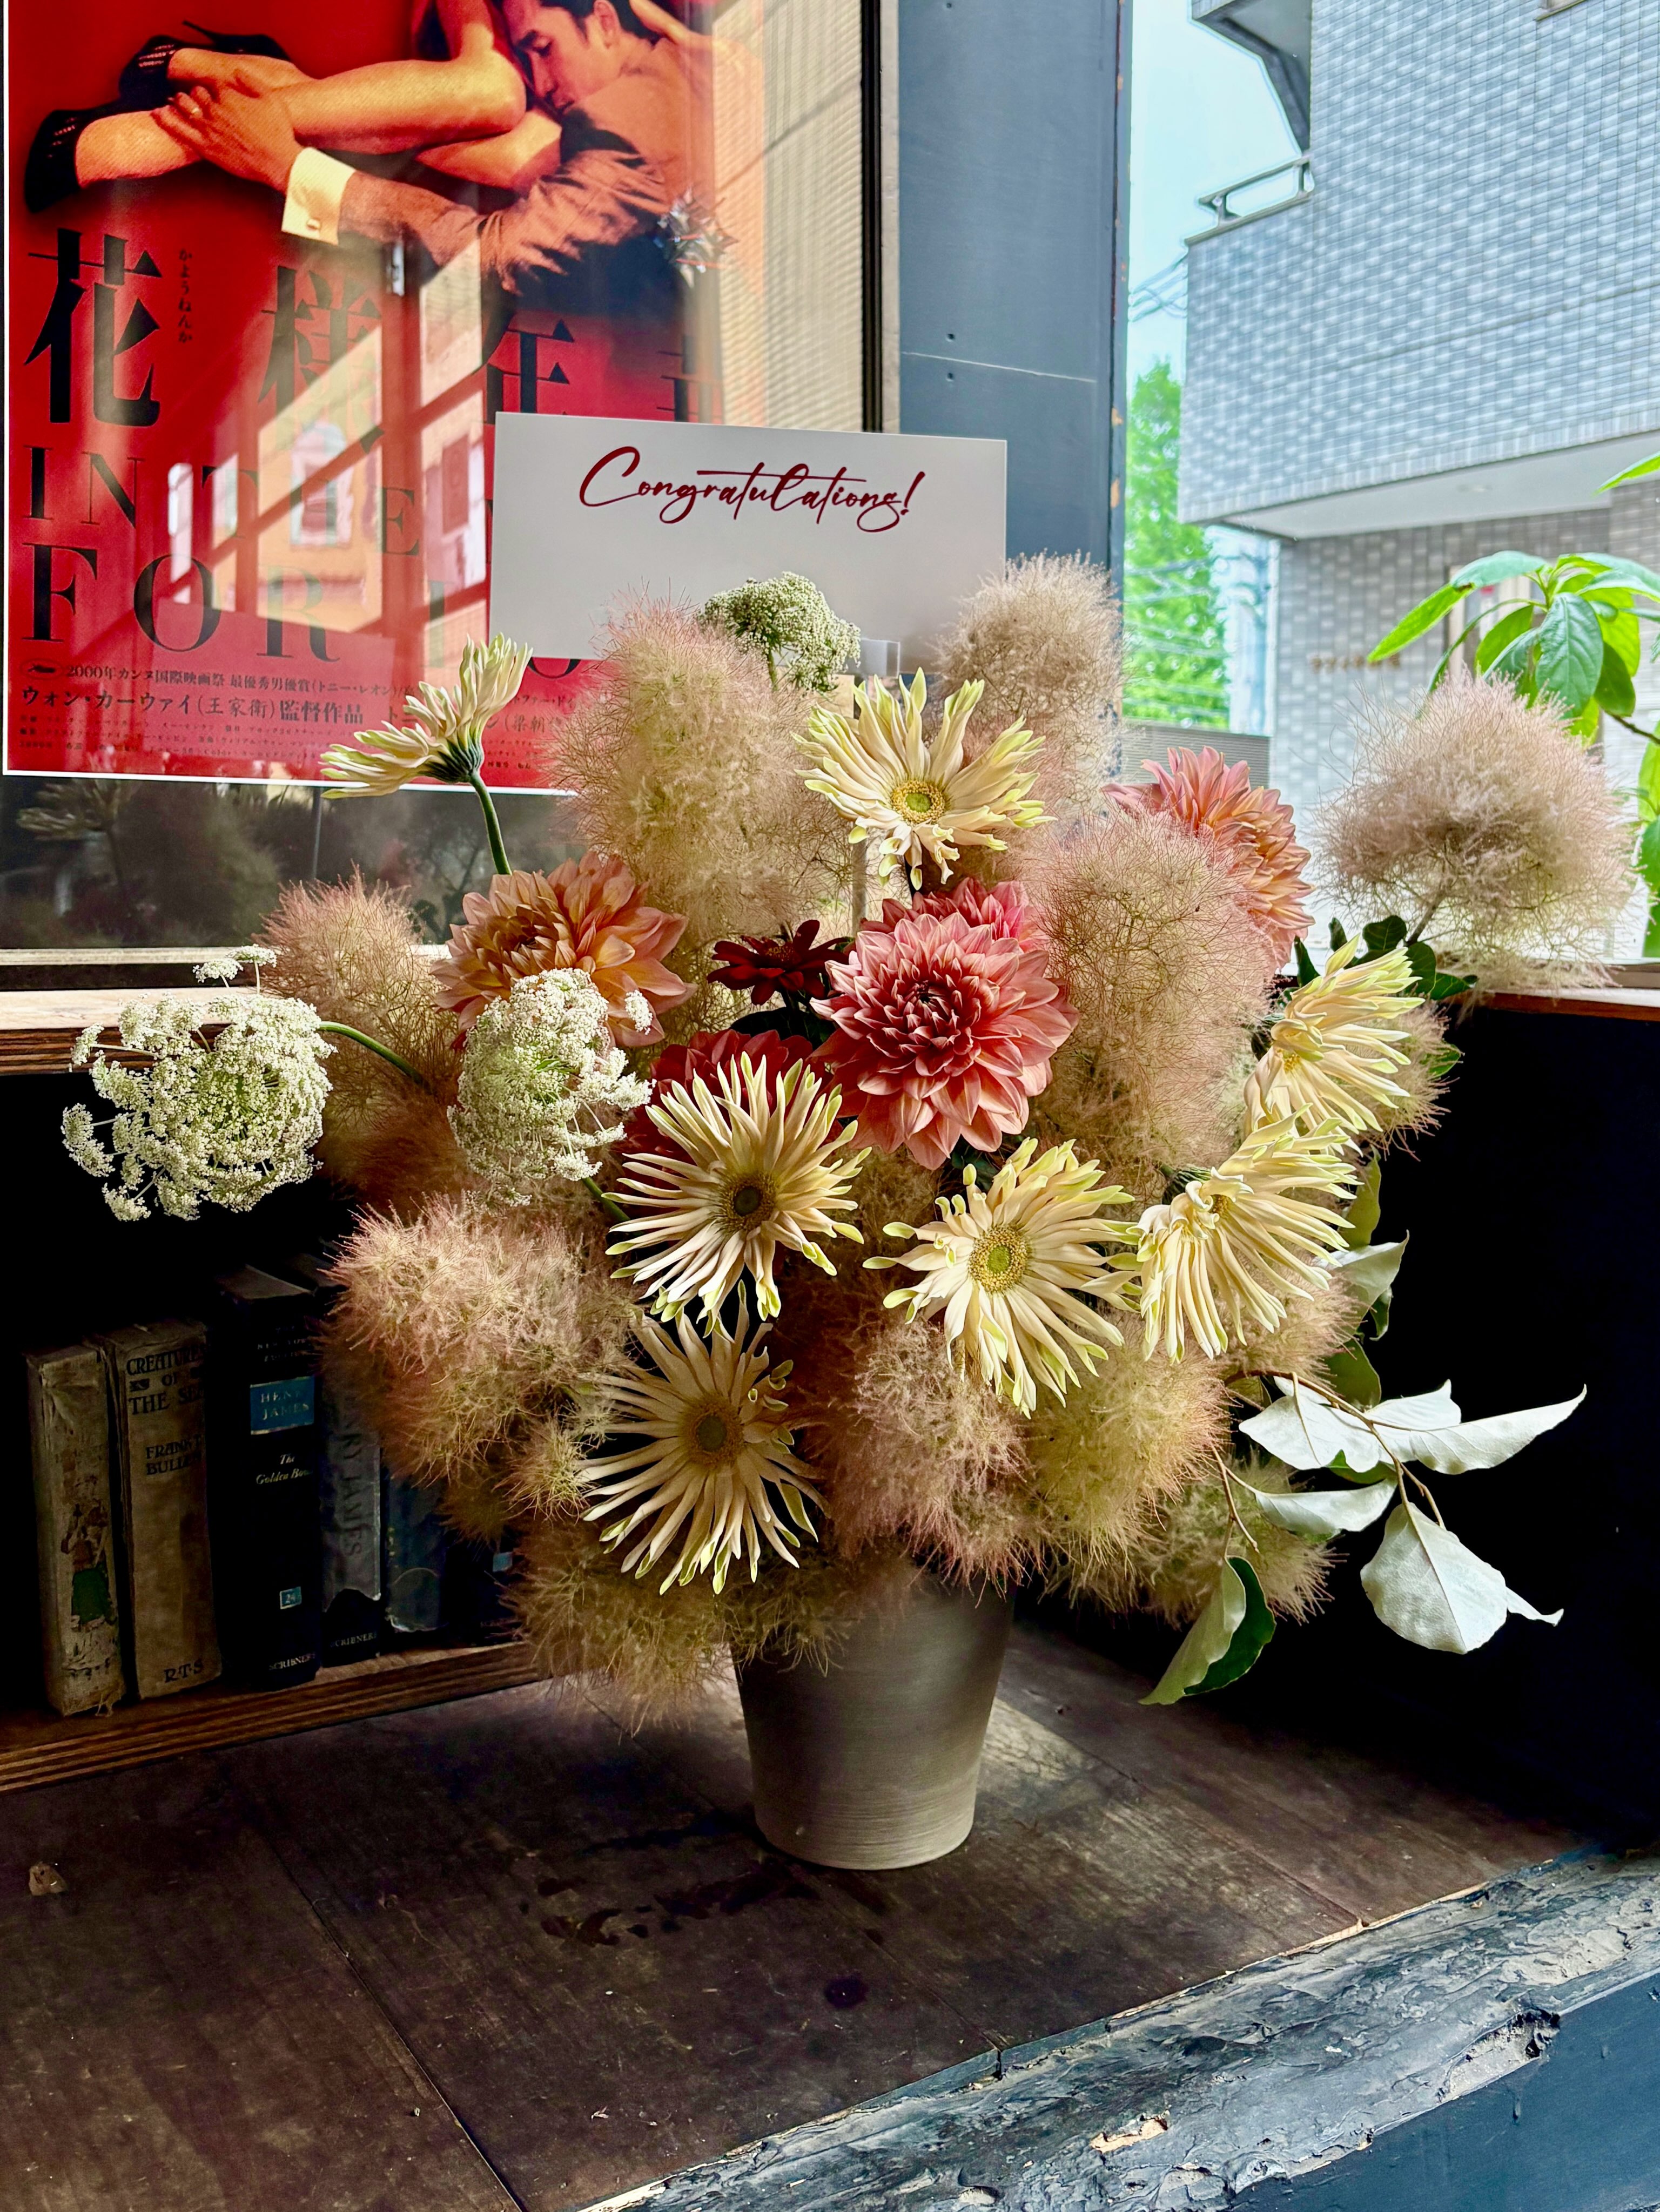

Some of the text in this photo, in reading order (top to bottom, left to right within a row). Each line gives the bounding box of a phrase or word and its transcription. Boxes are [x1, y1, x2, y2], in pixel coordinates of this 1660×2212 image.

[178, 248, 193, 343] かようねんか
[22, 444, 145, 530] IN
[579, 446, 926, 533] Congratulations!
[22, 542, 340, 663] FOR
[129, 1392, 171, 1415] THE
[256, 1470, 288, 1485] Golden
